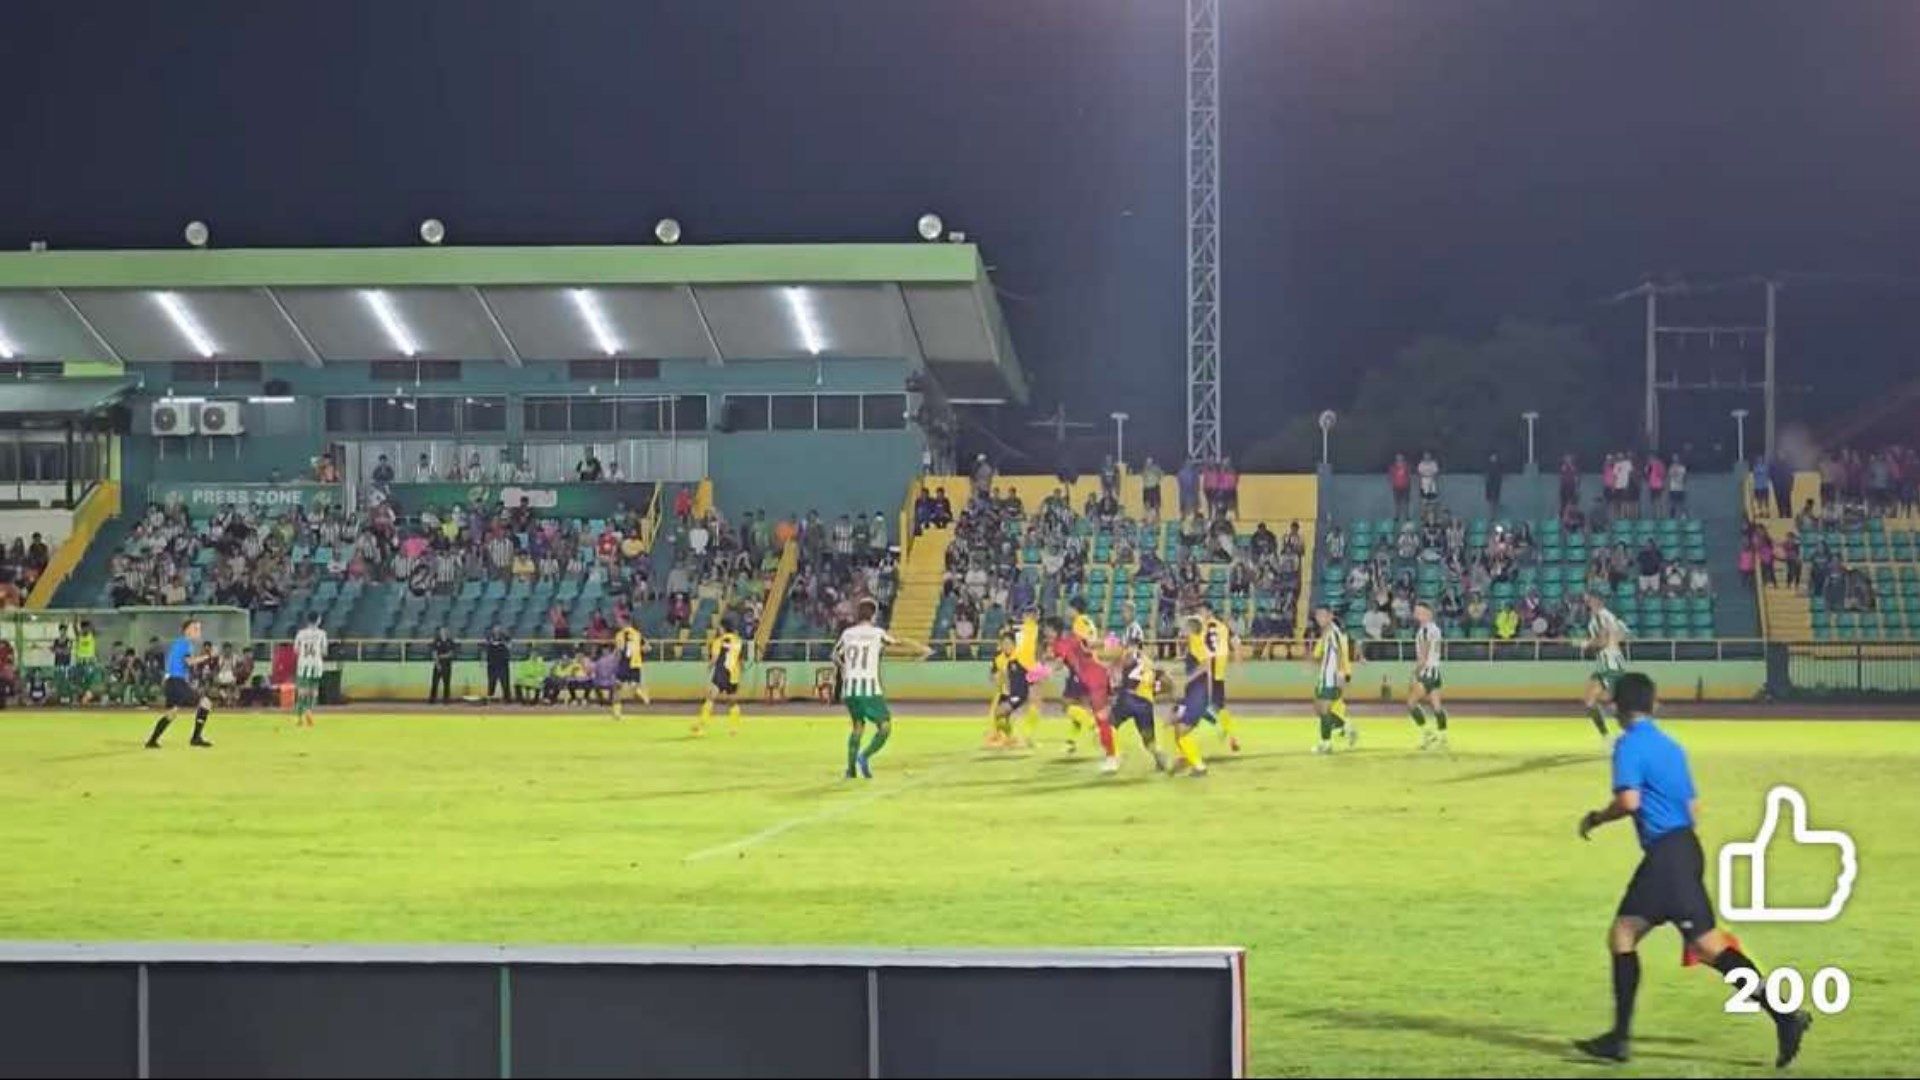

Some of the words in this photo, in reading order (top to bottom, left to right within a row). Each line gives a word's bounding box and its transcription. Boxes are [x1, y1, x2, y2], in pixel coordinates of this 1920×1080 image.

[192, 489, 249, 504] PRESS
[255, 490, 303, 504] ZONE
[846, 644, 870, 670] 91
